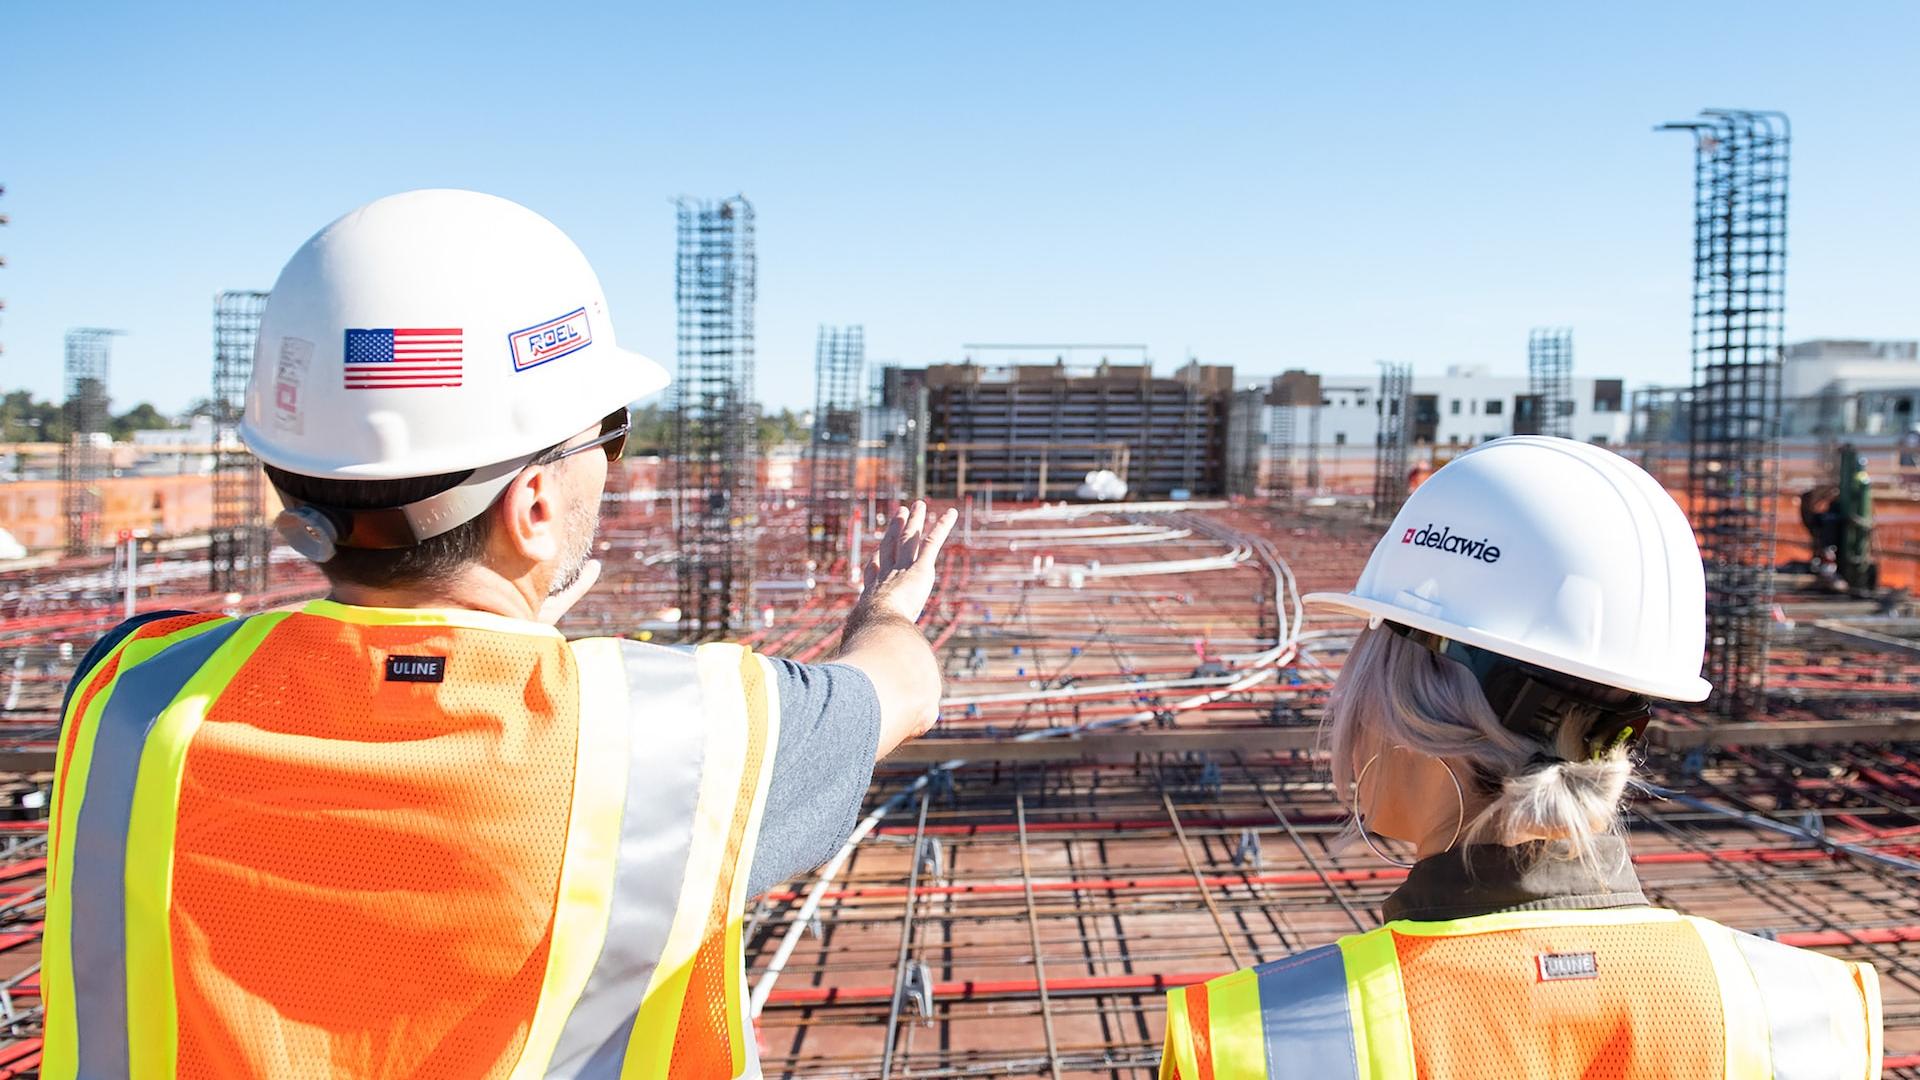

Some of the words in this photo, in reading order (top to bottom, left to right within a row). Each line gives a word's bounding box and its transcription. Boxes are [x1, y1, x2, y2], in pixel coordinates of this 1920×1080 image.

[529, 323, 579, 353] ROEL
[1414, 523, 1501, 563] delawie
[393, 661, 437, 675] ULINE
[1549, 957, 1592, 972] ULINE
